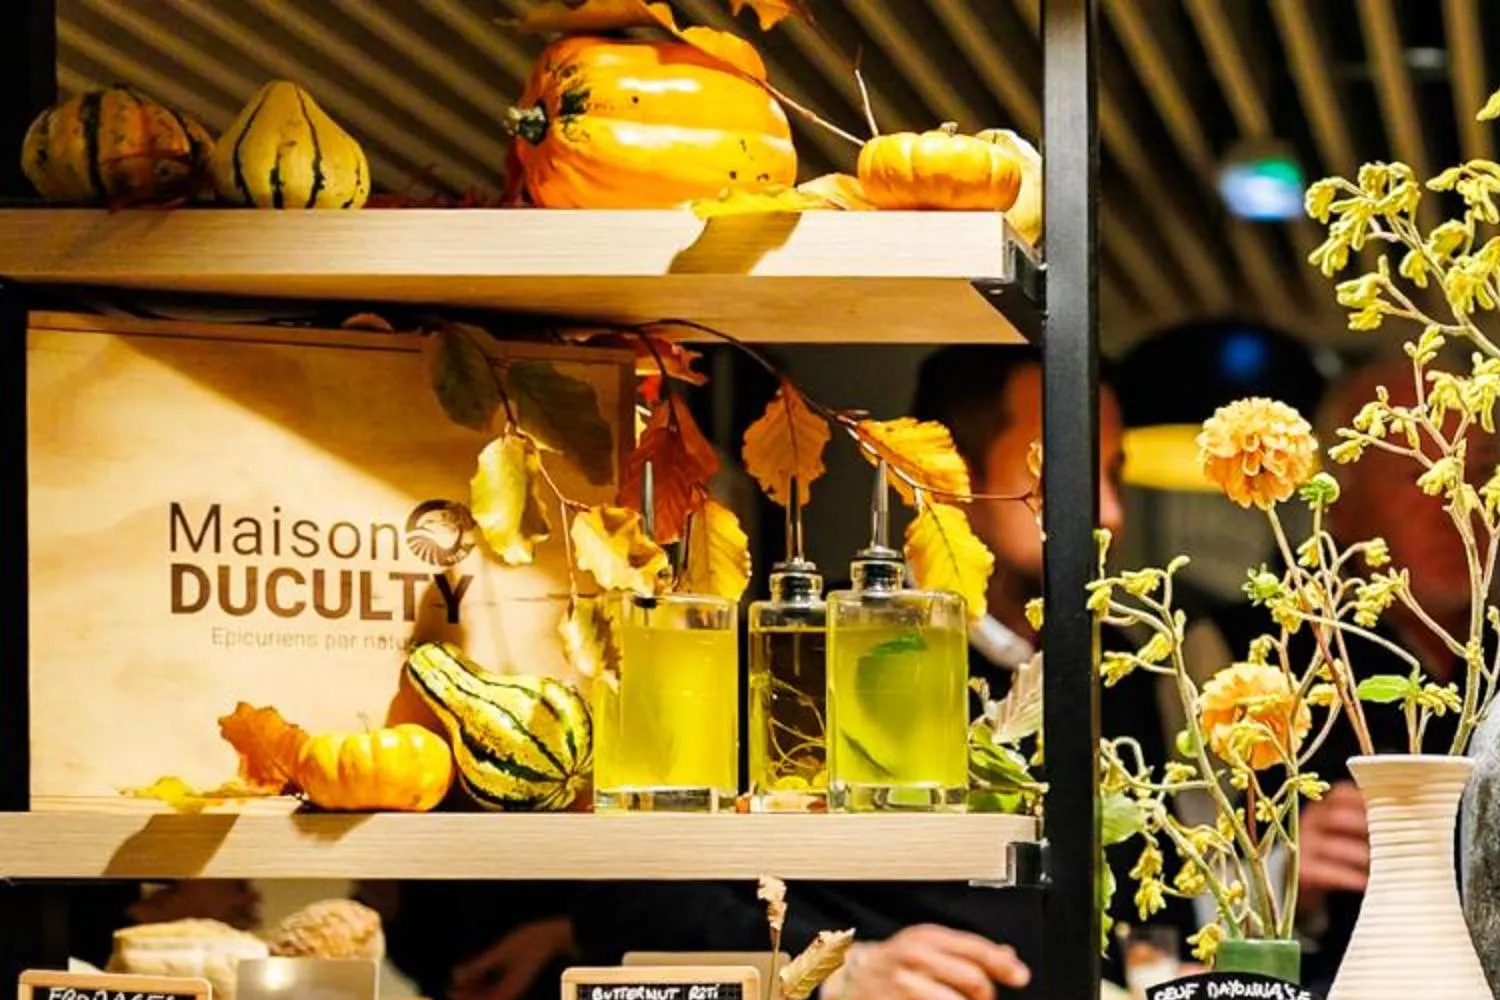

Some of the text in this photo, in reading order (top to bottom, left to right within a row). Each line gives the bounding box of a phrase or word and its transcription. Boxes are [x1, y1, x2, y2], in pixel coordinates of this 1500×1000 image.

[169, 502, 399, 560] Maison
[171, 563, 474, 624] DUCULTY
[325, 632, 358, 650] par
[364, 634, 409, 650] natu
